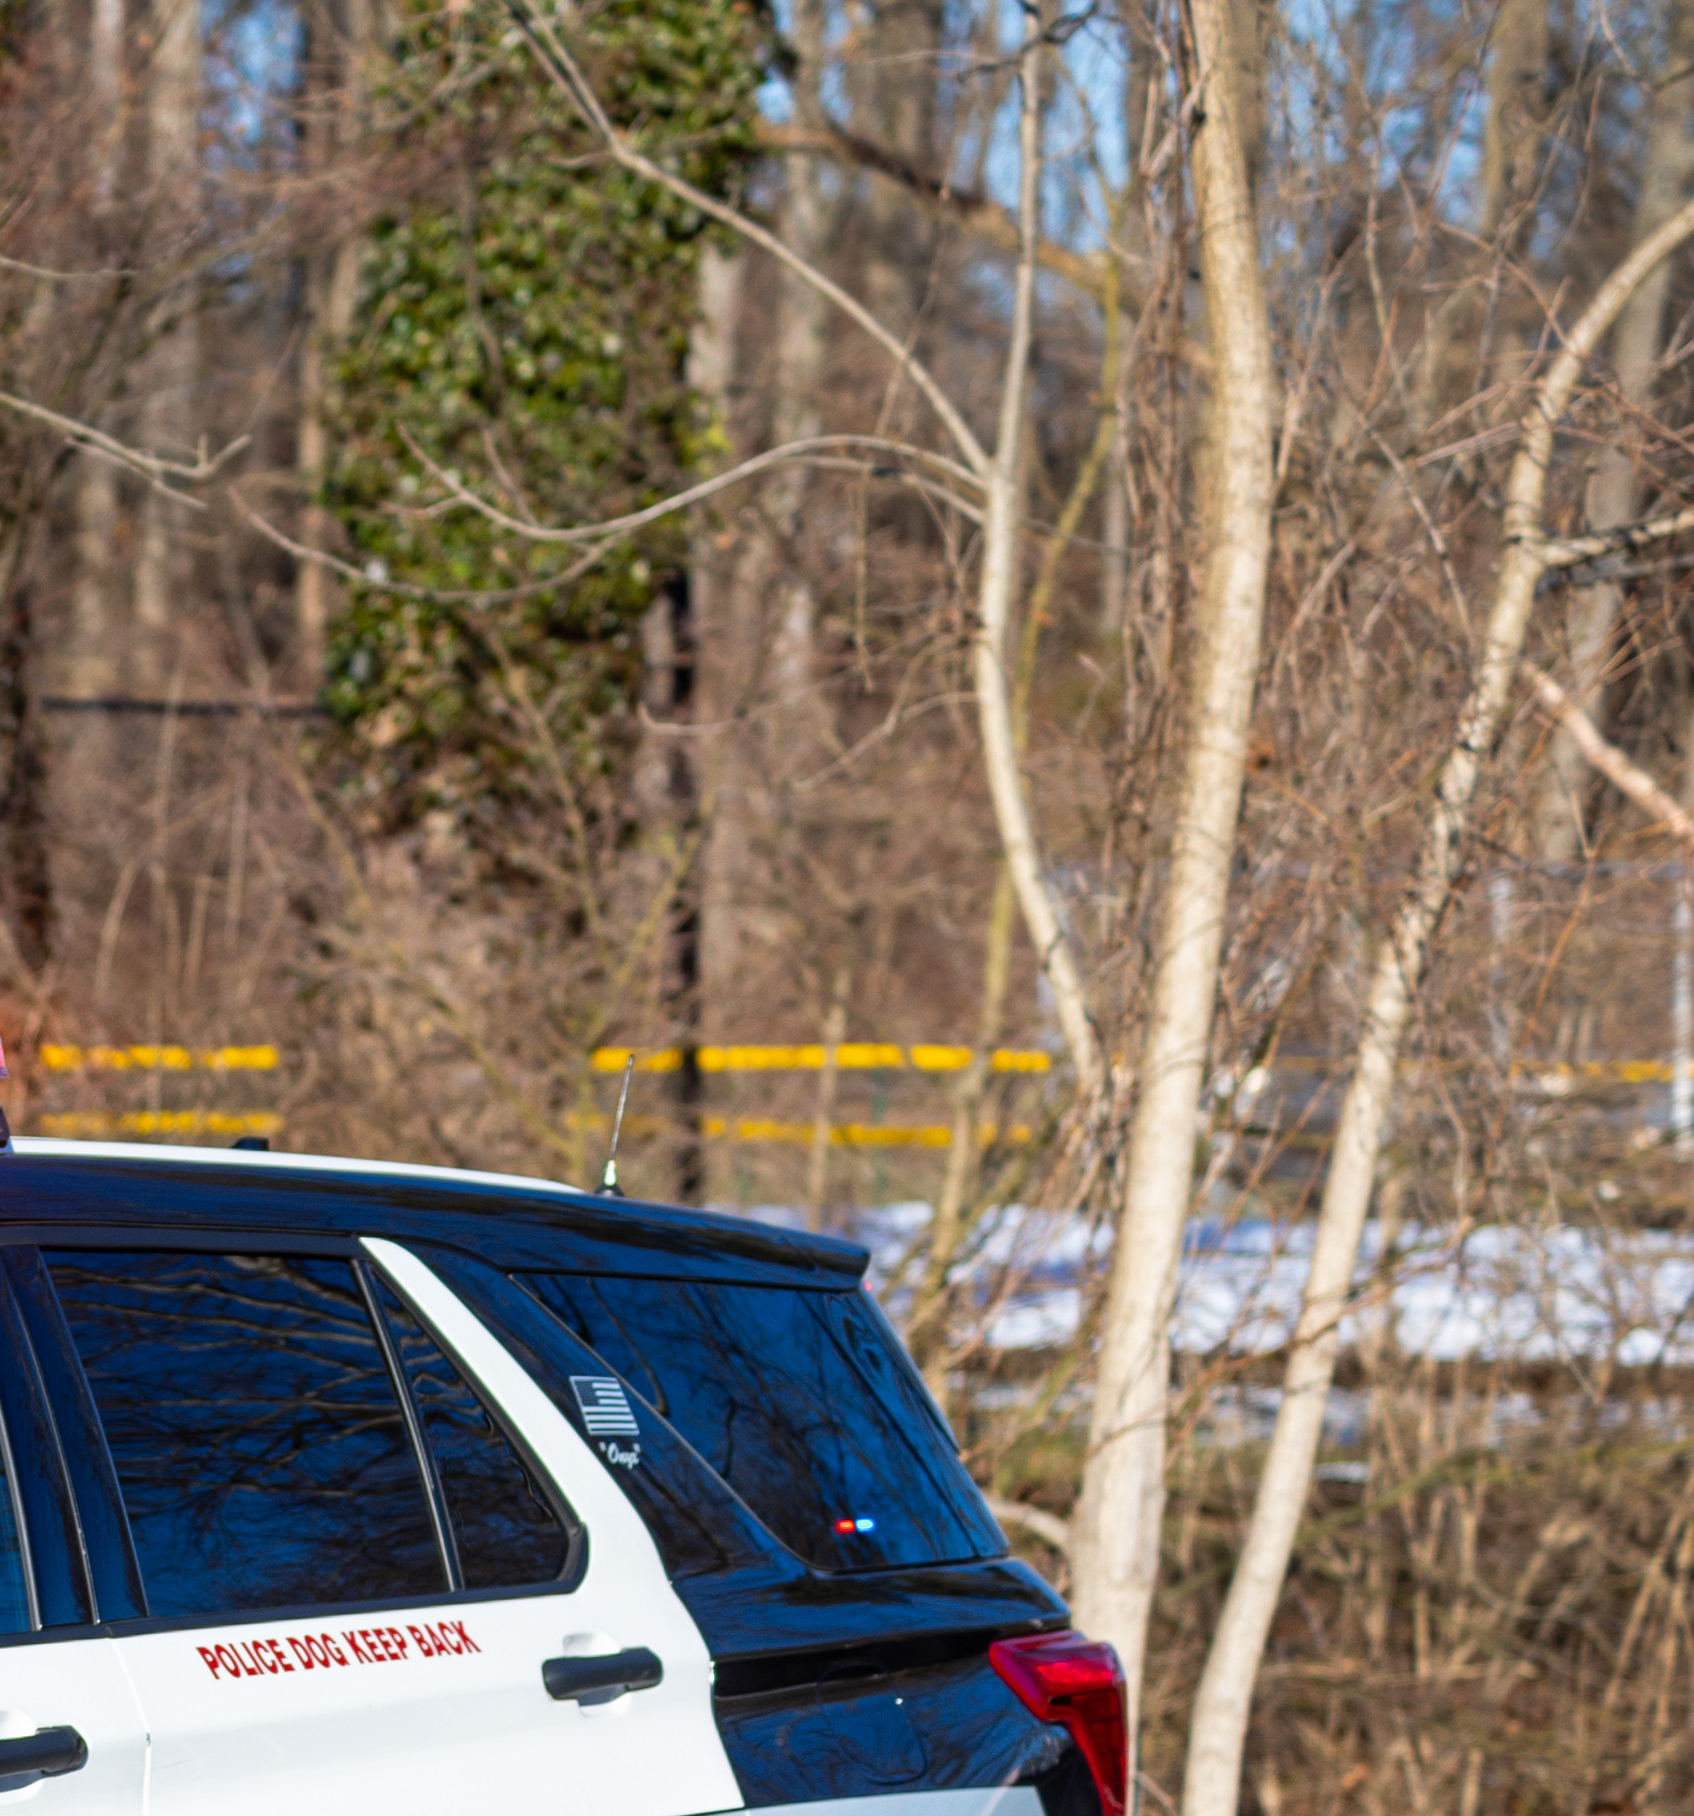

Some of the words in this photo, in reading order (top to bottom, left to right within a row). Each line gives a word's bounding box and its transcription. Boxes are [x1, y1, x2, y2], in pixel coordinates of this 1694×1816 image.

[196, 1639, 295, 1680] POLICE
[286, 1633, 350, 1670] DOG
[341, 1627, 408, 1664] KEEP
[406, 1620, 482, 1657] BACK
